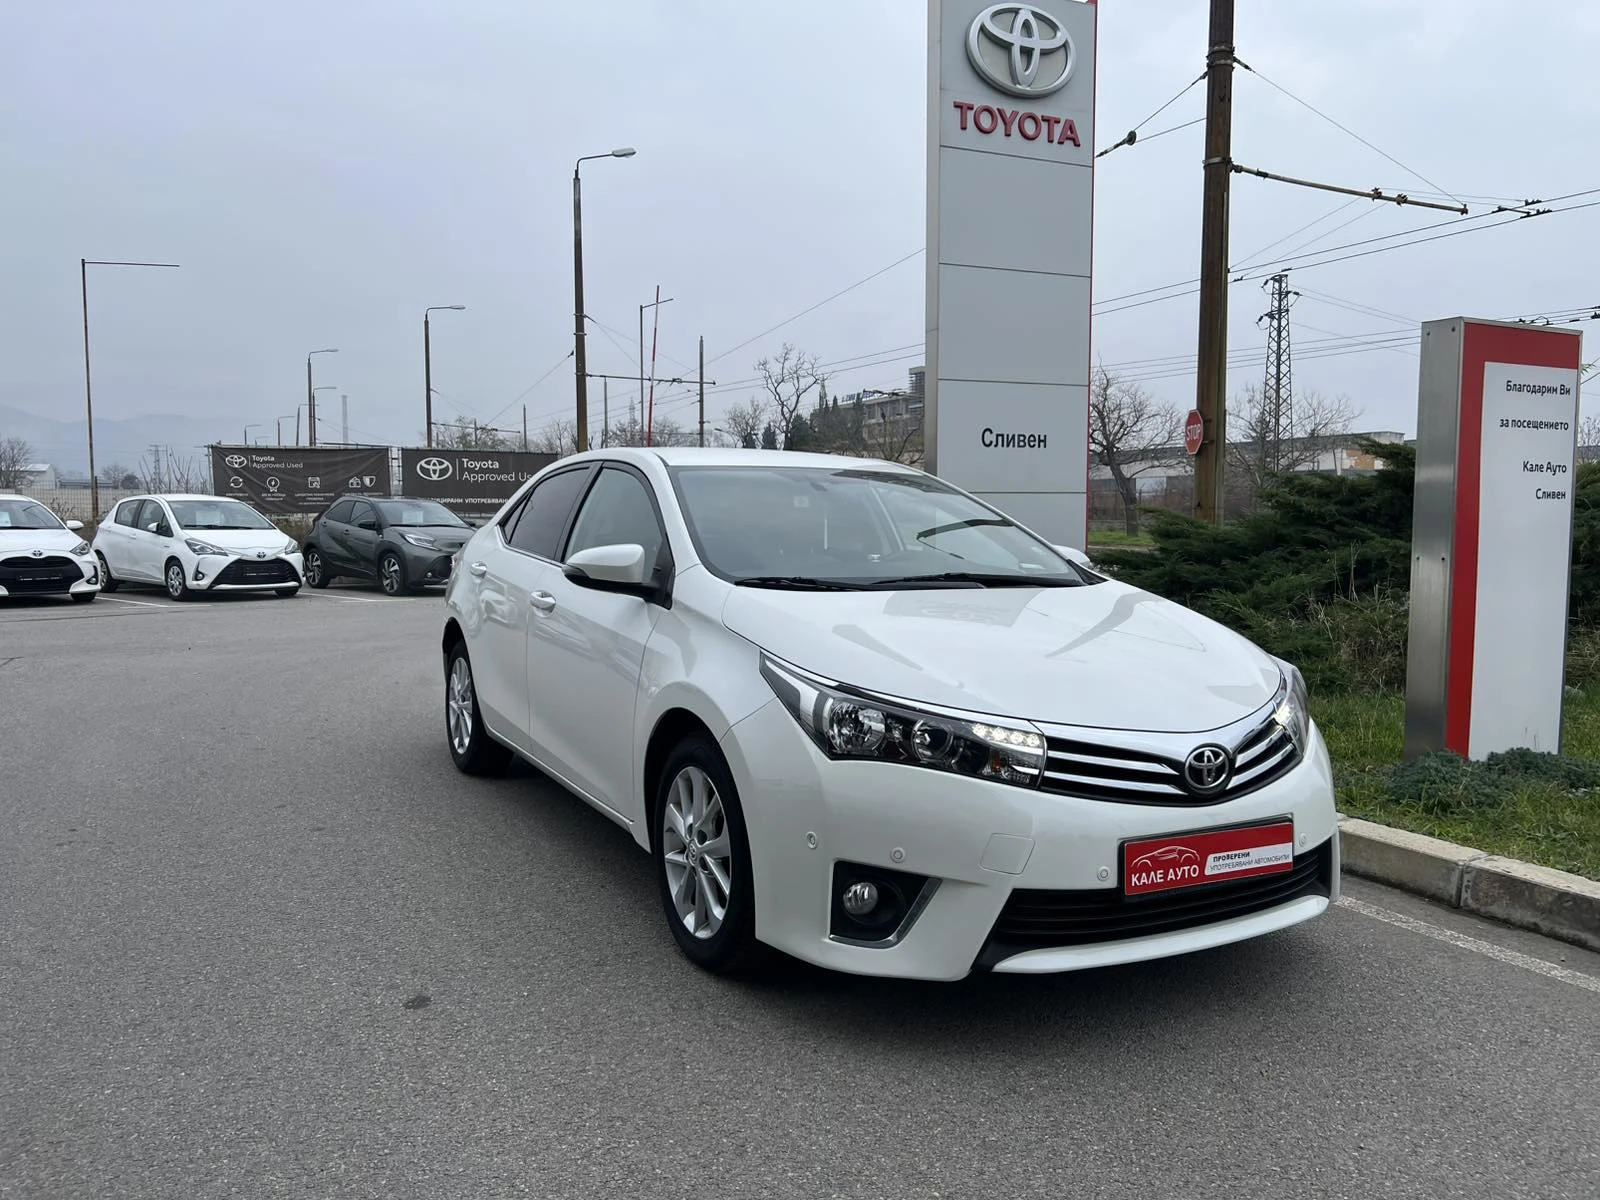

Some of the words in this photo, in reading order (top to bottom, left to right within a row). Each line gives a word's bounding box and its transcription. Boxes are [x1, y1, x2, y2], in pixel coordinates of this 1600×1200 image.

[953, 101, 1081, 147] TOYOTA
[1506, 380, 1558, 396] Благодарим
[1560, 384, 1571, 395] Ви
[1500, 419, 1510, 428] за
[1511, 419, 1569, 430] посещението
[981, 427, 1047, 449] Сливен
[1186, 424, 1201, 441] STOP
[462, 458, 500, 470] Toyota
[1522, 461, 1545, 472] Кале
[1545, 461, 1567, 476] Ауто
[462, 471, 515, 483] Approved
[1535, 488, 1566, 499] Сливен
[1213, 852, 1250, 862] ПРОВЕРЕНИ
[1131, 870, 1164, 886] КАЛЕ
[1167, 865, 1199, 881] АУТО
